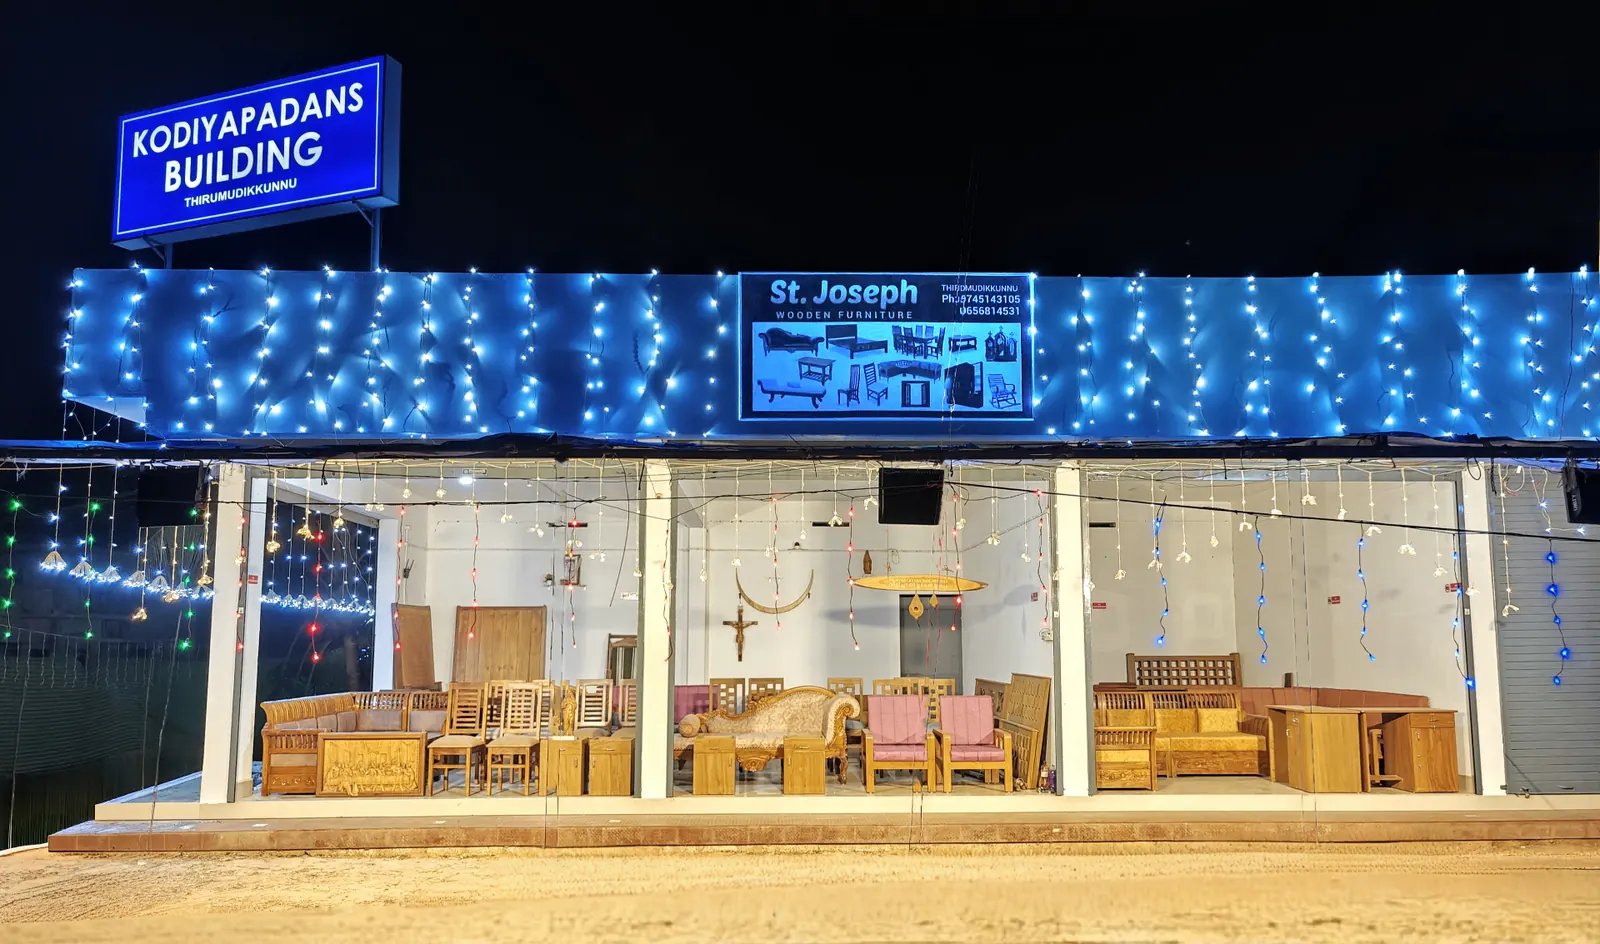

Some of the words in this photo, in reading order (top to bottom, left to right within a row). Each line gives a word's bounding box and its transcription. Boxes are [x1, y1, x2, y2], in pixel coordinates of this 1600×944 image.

[133, 82, 363, 158] KODIYAPADANS
[164, 131, 323, 193] BUILDING
[184, 178, 298, 208] THIRUMUDIKKUNNU
[770, 279, 807, 304] St.
[812, 278, 918, 310] Joseph
[776, 311, 831, 320] WOODEN
[838, 311, 913, 319] FURNITURE
